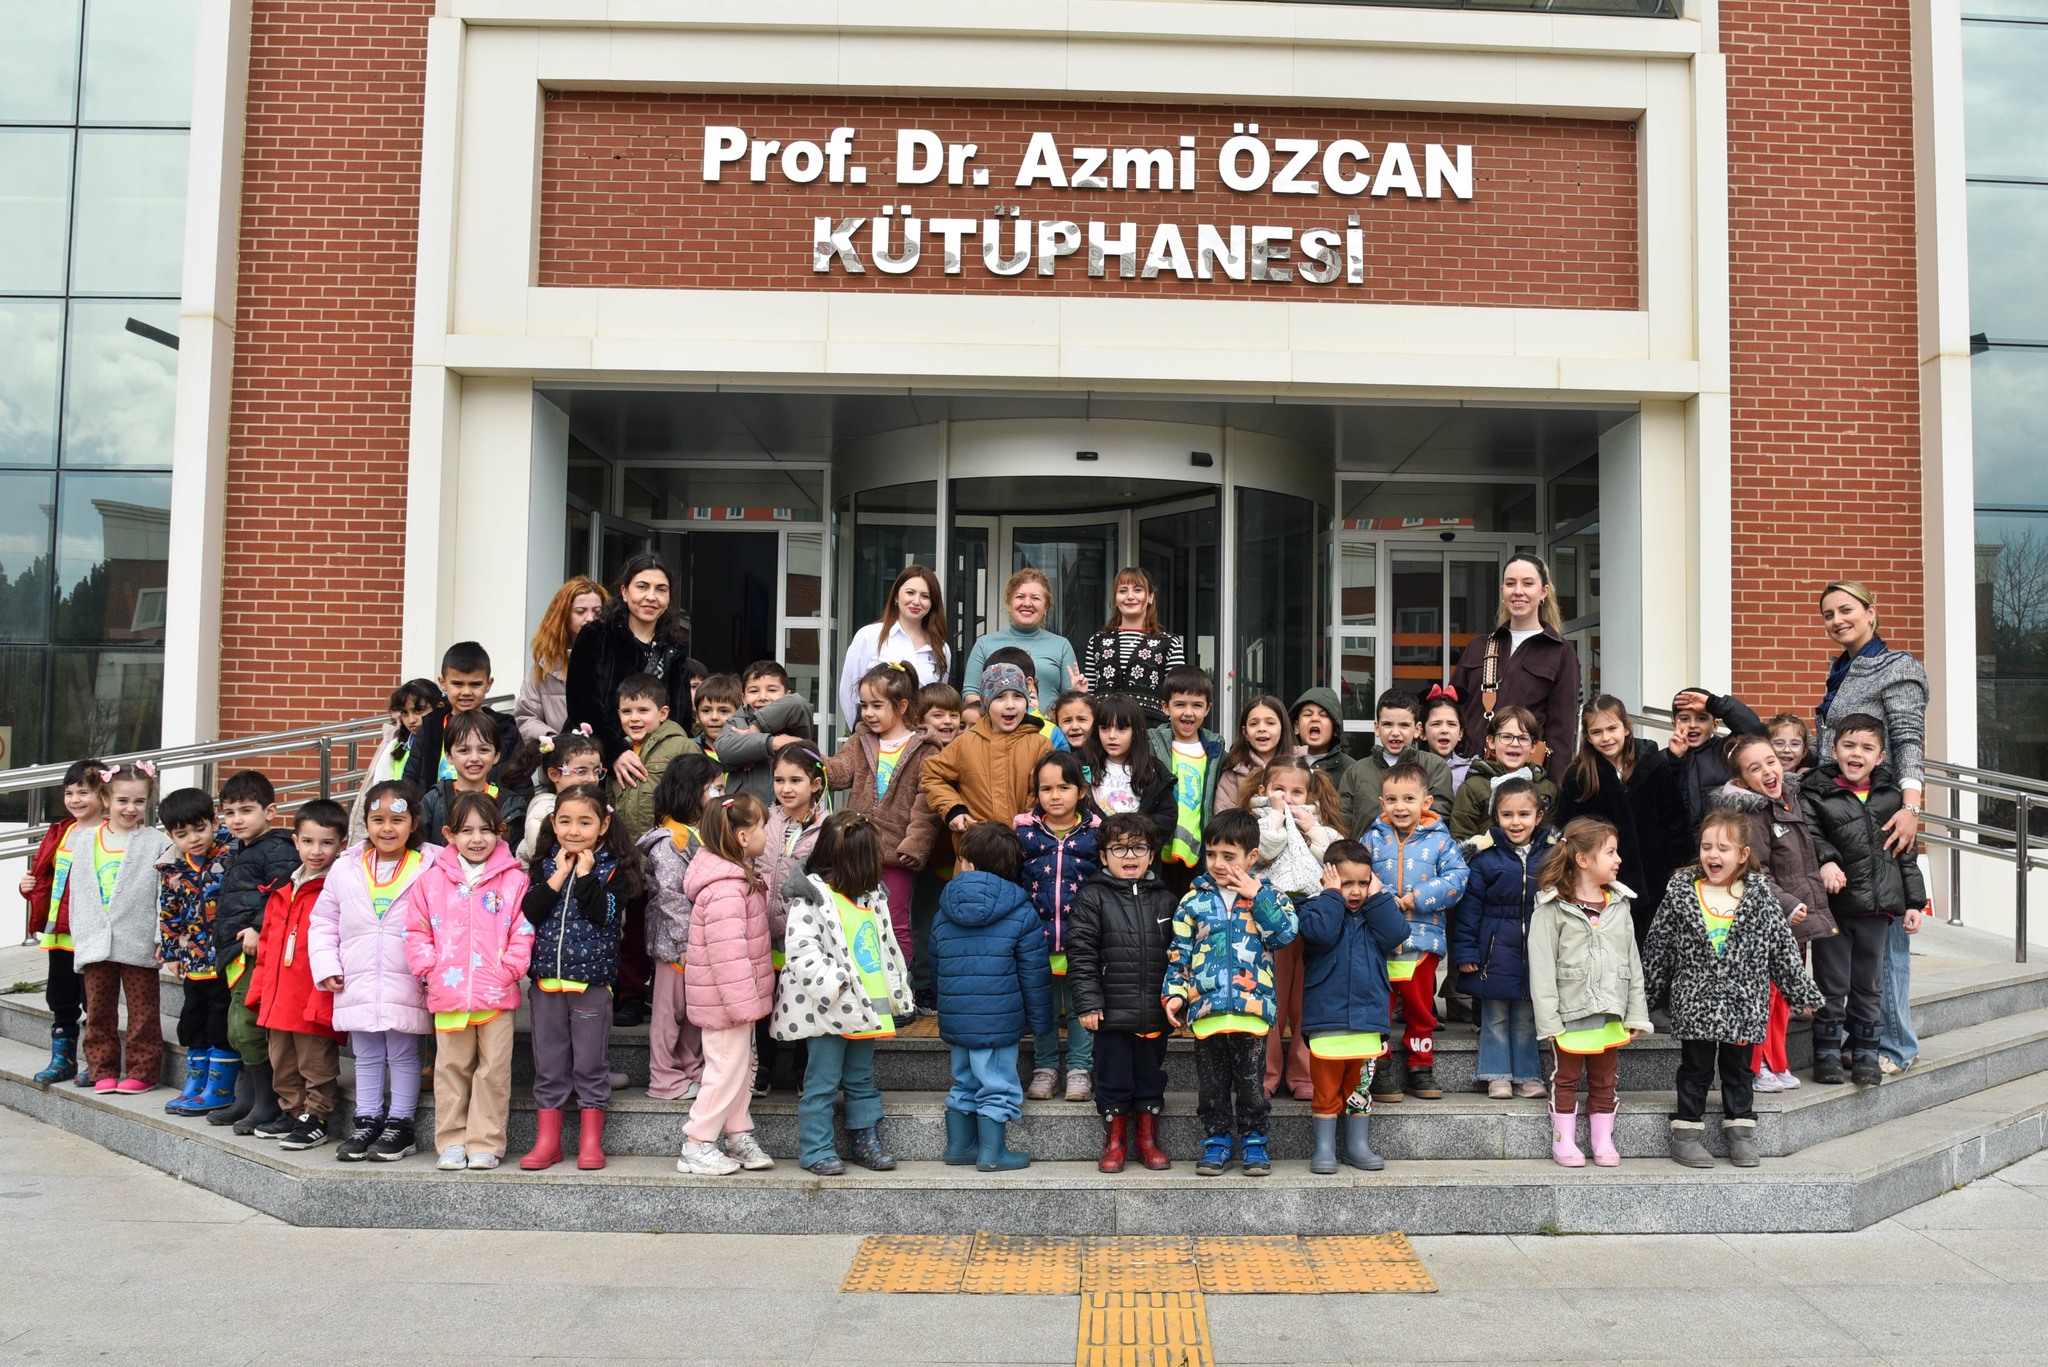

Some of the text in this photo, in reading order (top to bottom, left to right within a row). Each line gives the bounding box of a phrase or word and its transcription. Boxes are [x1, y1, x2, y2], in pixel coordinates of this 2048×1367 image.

[702, 123, 1474, 200] Prof. Dr. Azmi ÖZCAN
[813, 205, 1364, 284] KÜTÜPHANESİ
